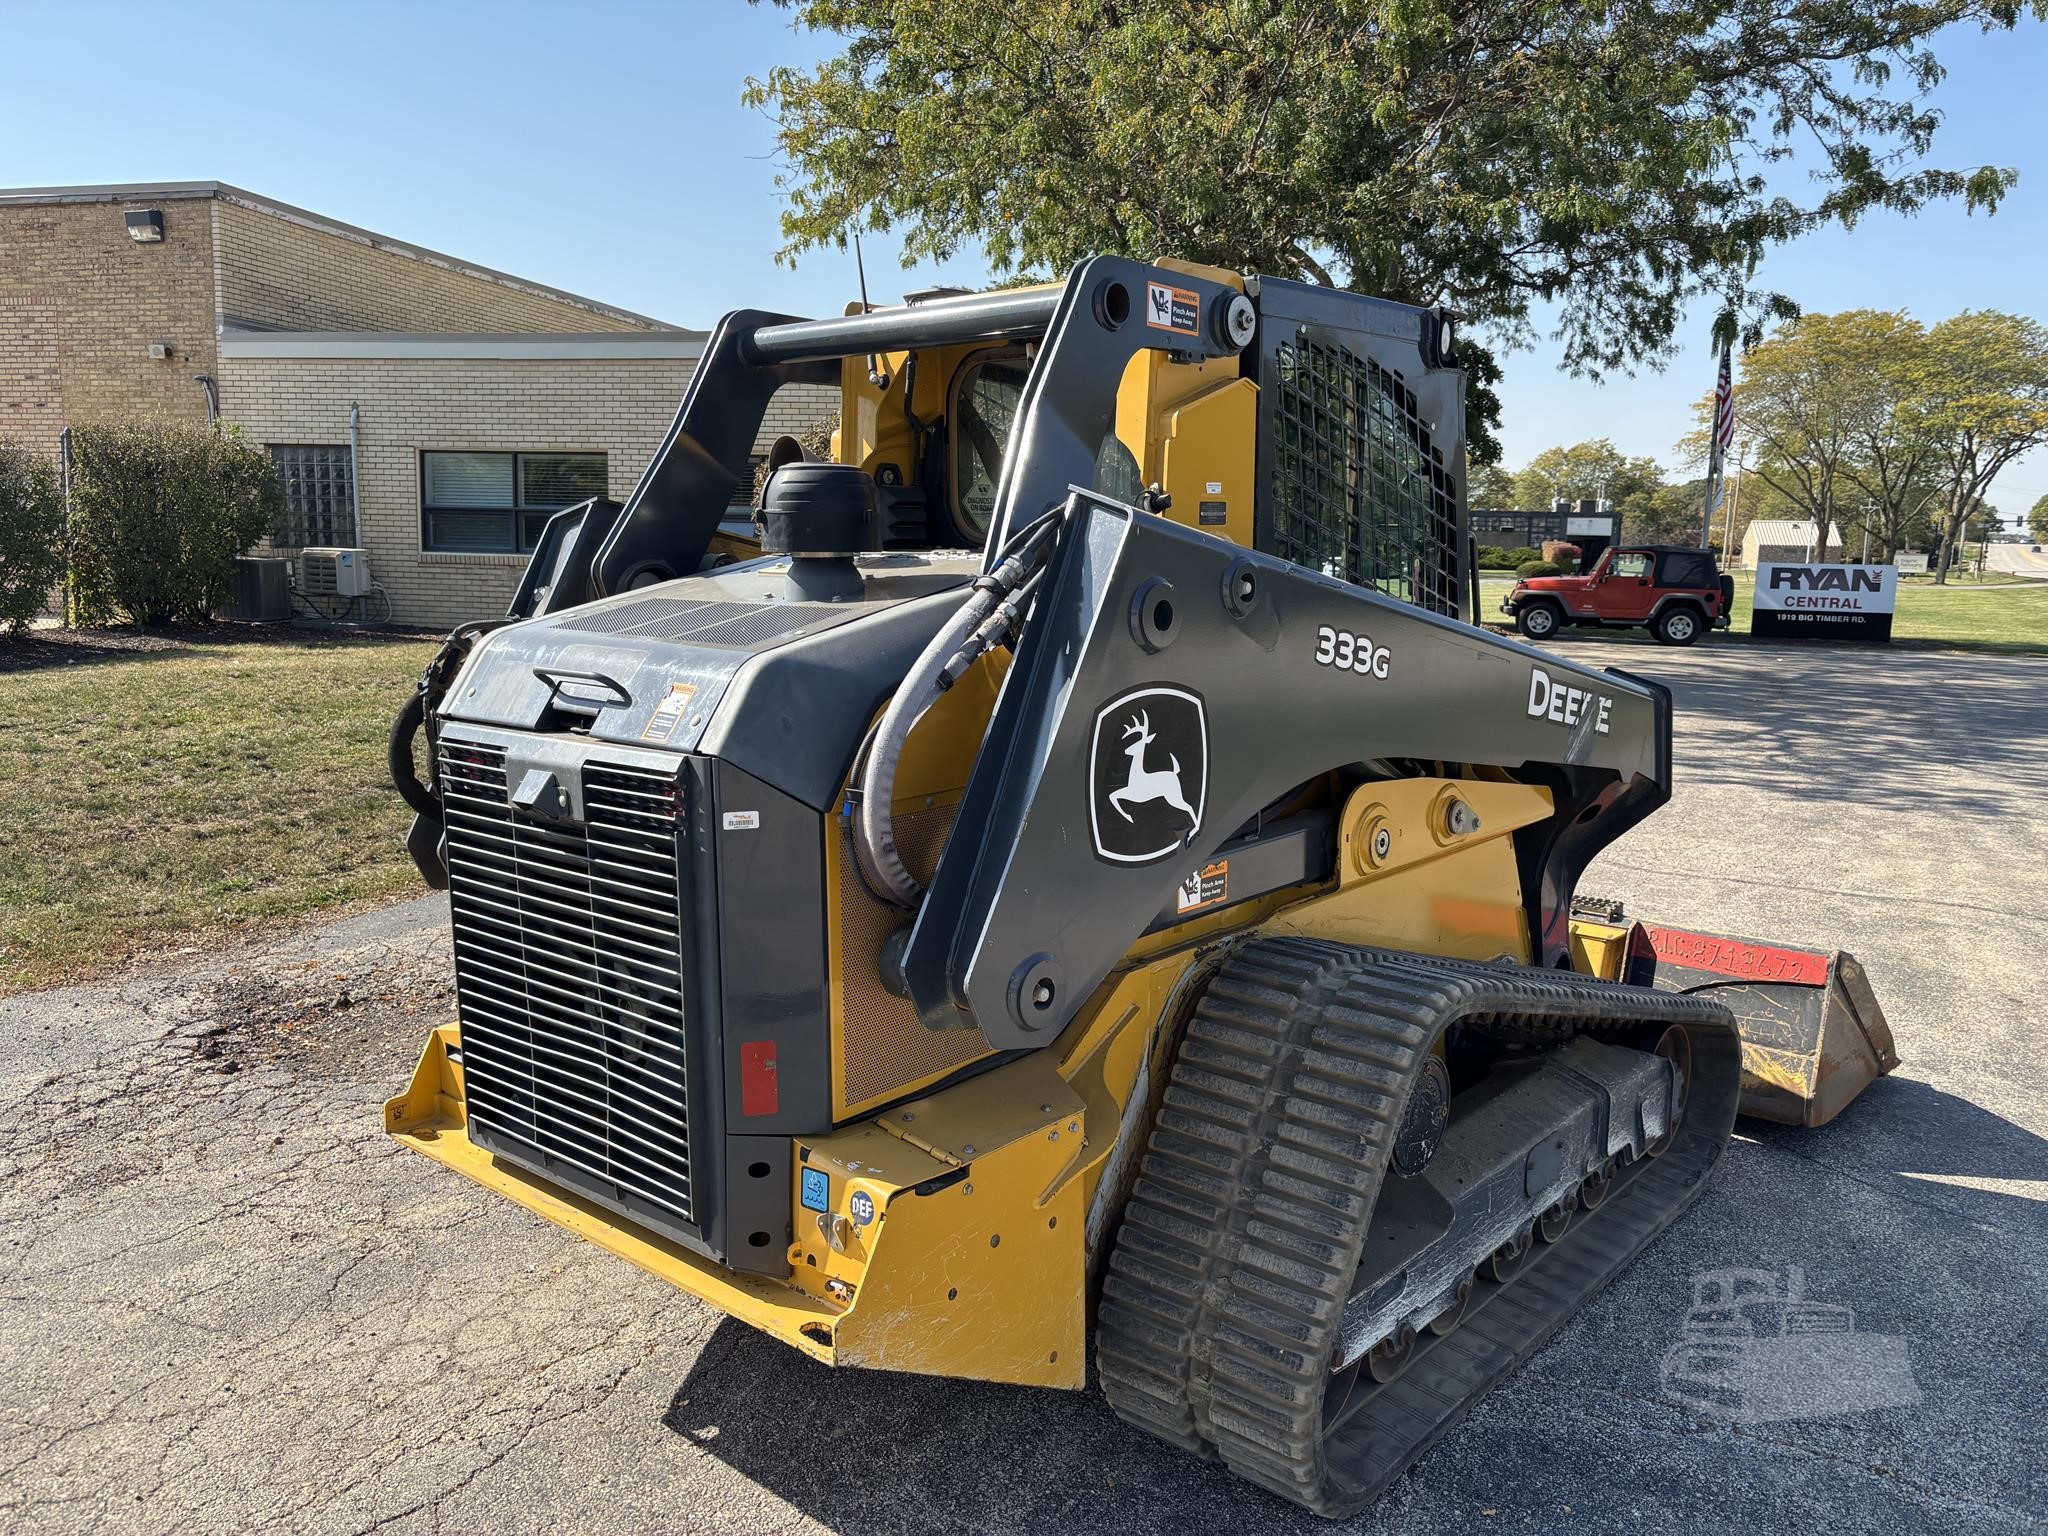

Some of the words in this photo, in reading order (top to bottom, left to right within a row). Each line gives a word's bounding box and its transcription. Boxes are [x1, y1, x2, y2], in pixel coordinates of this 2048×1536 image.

[1173, 306, 1185, 315] Pinch
[1186, 309, 1196, 317] Area
[1173, 316, 1182, 324] Keep
[1183, 318, 1192, 326] Away
[1769, 567, 1881, 592] RYAN
[1871, 569, 1883, 583] INC
[1784, 596, 1863, 609] CENTRAL
[1777, 613, 1796, 621] 1919
[1798, 614, 1814, 622] BIG
[1816, 614, 1850, 623] TIMBER
[1851, 616, 1867, 624] RD.
[1316, 627, 1391, 679] 333G
[853, 1197, 872, 1217] DEF
